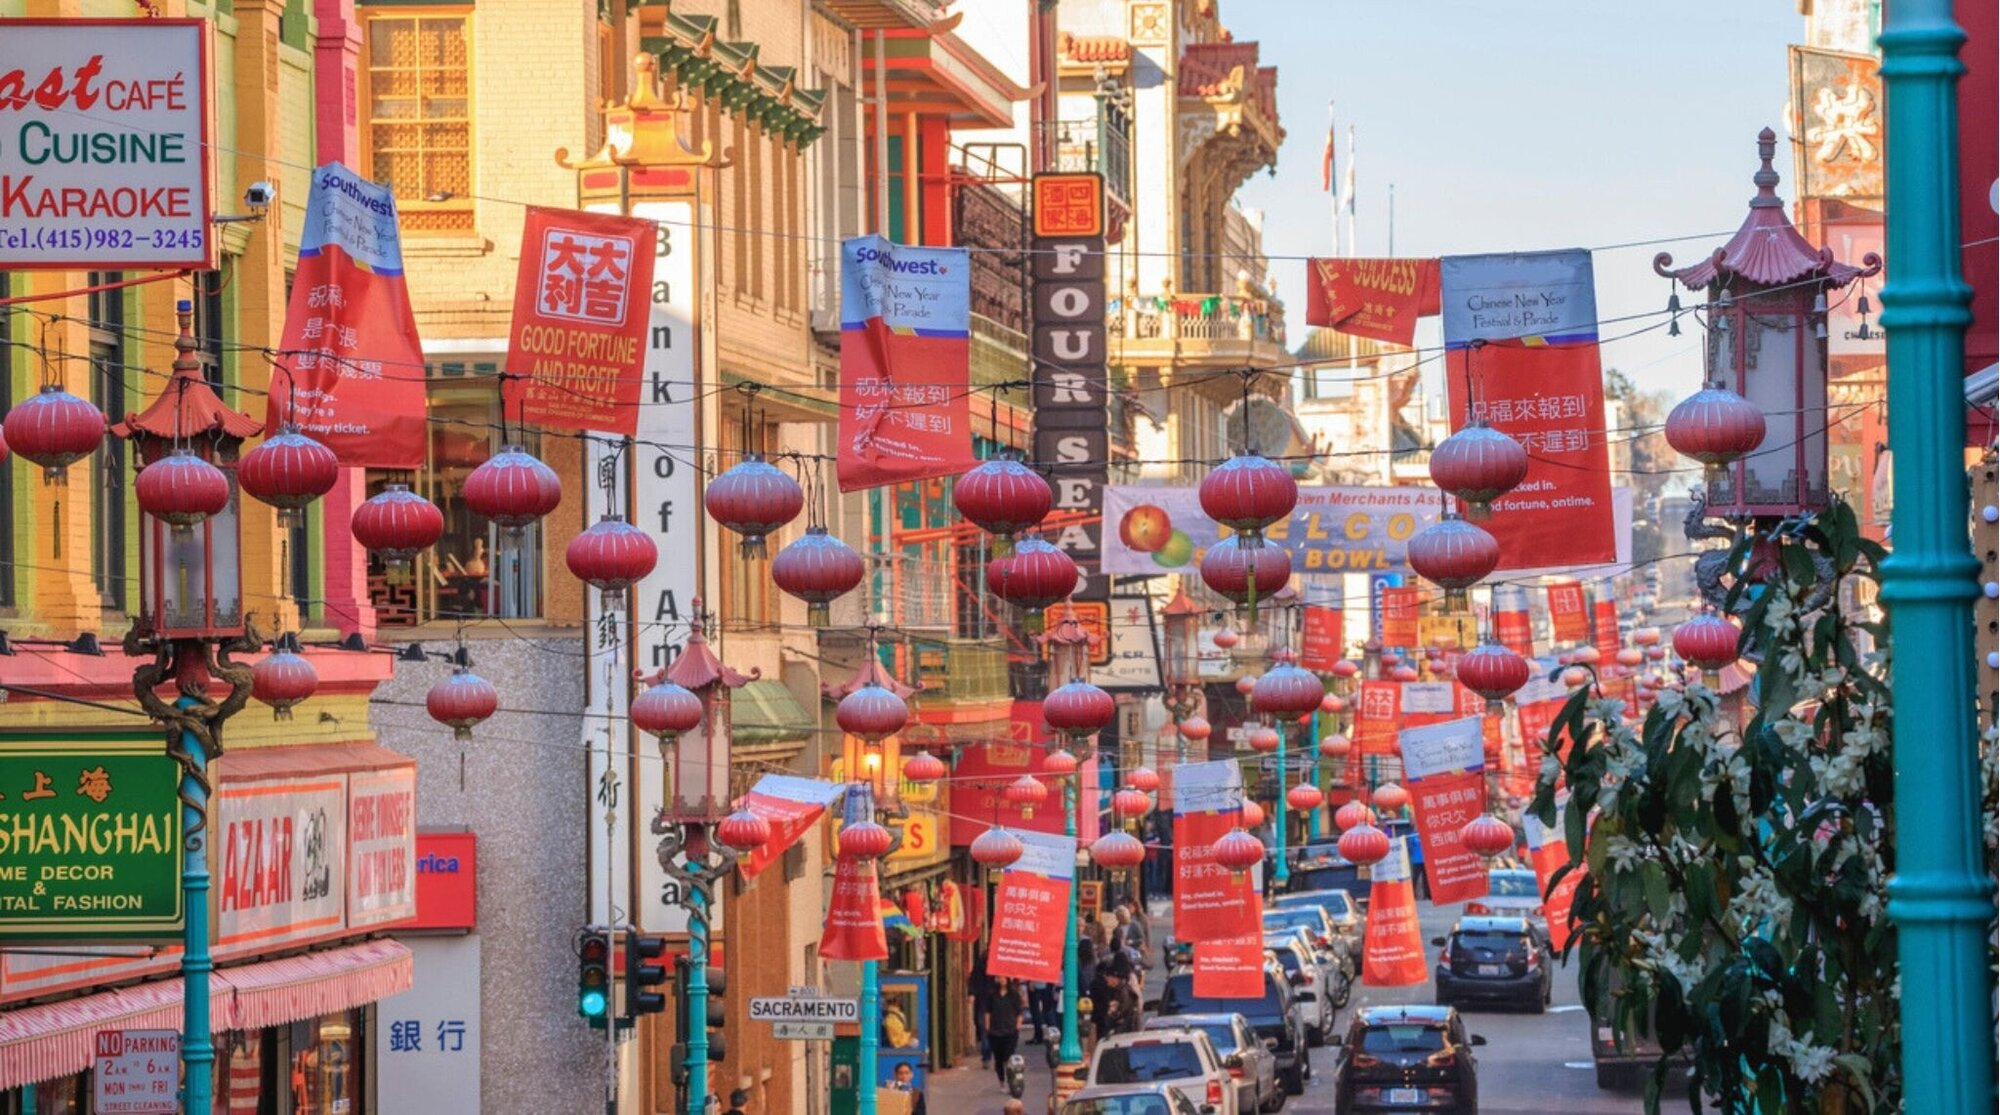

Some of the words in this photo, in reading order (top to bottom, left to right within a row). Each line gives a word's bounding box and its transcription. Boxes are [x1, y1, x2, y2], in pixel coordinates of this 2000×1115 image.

[106, 72, 187, 111] CAFÉ
[20, 120, 186, 165] CUISINE
[2, 175, 192, 218] KARAOKE
[321, 172, 395, 218] Southwest
[888, 285, 912, 300] New
[914, 287, 941, 301] Year
[1467, 295, 1512, 311] Chinese
[1515, 294, 1539, 308] New
[1540, 291, 1566, 307] Year
[894, 303, 932, 318] Parade
[1473, 312, 1511, 329] Festival
[1523, 311, 1560, 327] Parade
[1051, 243, 1092, 404] FOUR
[520, 325, 564, 357] GOOD
[567, 330, 638, 365] FORTUNE
[530, 358, 563, 387] AND
[564, 363, 620, 395] PROFIT
[653, 456, 675, 533] of
[1542, 480, 1557, 491] in.
[1329, 492, 1411, 506] Merchants
[1504, 499, 1550, 511] fortune,
[1552, 496, 1595, 509] ontime.
[1304, 547, 1391, 569] BOWL
[0, 813, 171, 855] SHANGHAI
[41, 866, 115, 881] DECOR
[33, 881, 47, 895] &
[53, 895, 143, 910] FASHION
[752, 1001, 856, 1017] SACRAMENTO
[98, 1031, 121, 1055] NO
[124, 1036, 177, 1053] PARKING
[389, 1019, 467, 1052] 銀行
[104, 1060, 114, 1075] 2
[146, 1058, 156, 1074] 6
[104, 1082, 125, 1096] MON
[152, 1080, 169, 1094] FRI
[104, 1102, 132, 1111] STREET
[133, 1101, 173, 1111] CLEANING
